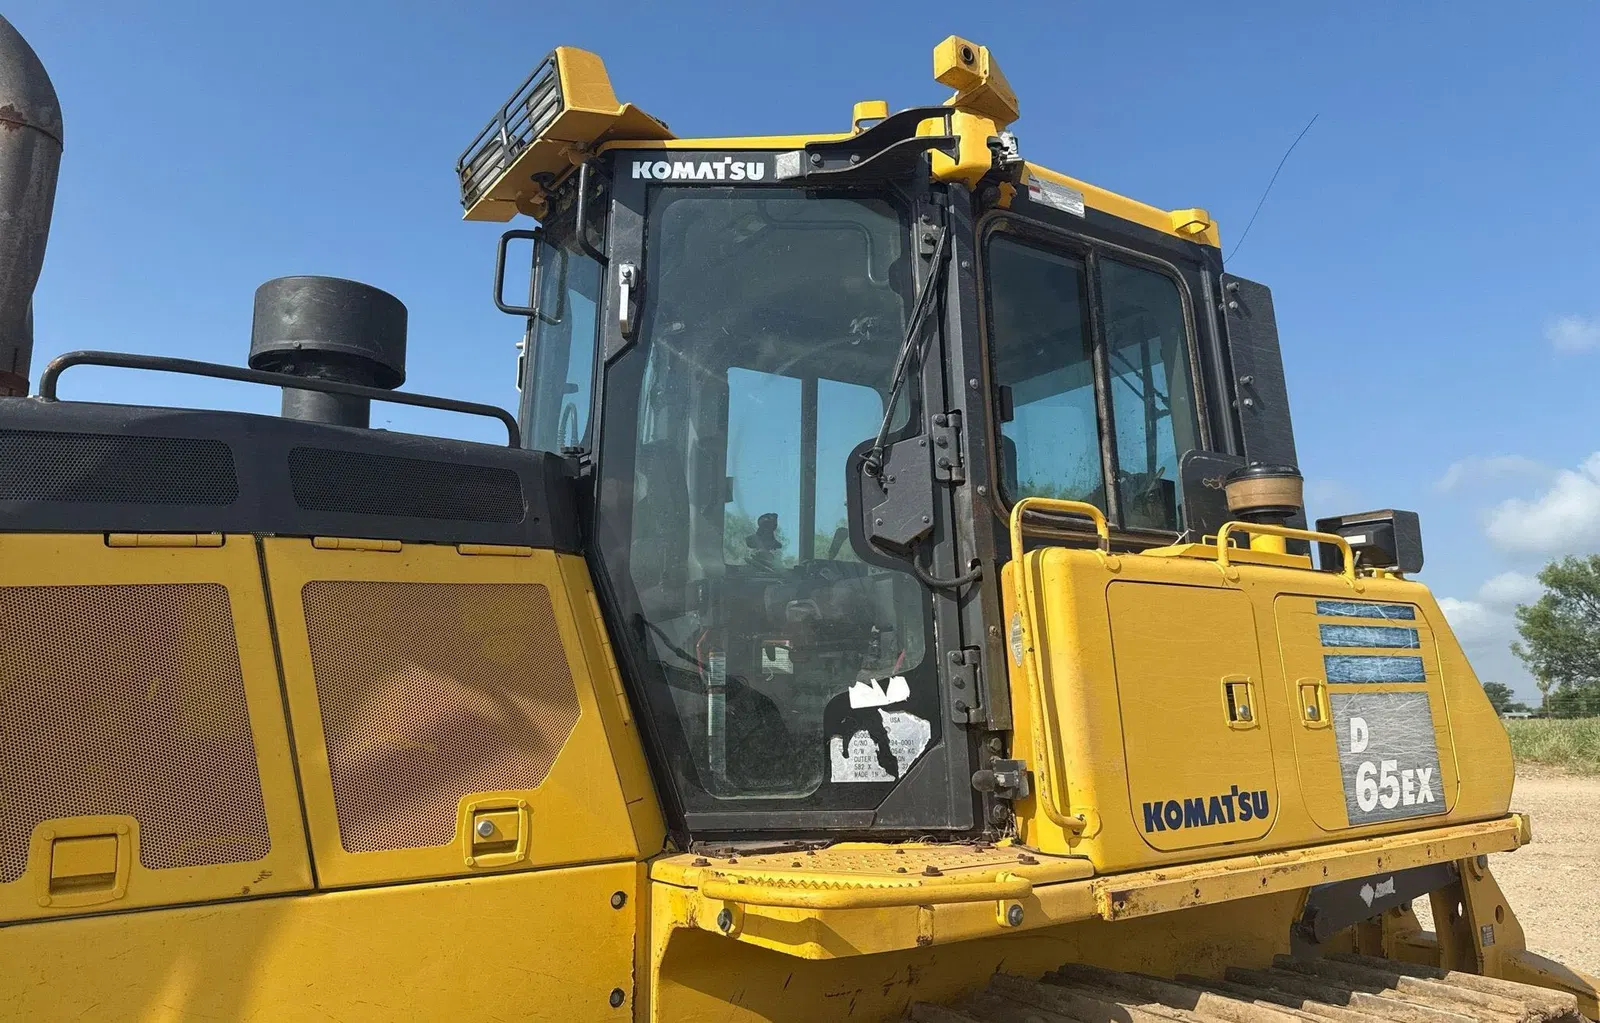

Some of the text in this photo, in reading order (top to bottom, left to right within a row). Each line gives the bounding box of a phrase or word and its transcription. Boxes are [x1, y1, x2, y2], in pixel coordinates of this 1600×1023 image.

[632, 156, 765, 180] KOMATSU
[1350, 717, 1370, 753] D
[1355, 759, 1436, 812] 65EX
[1142, 784, 1269, 832] KOMATSU
